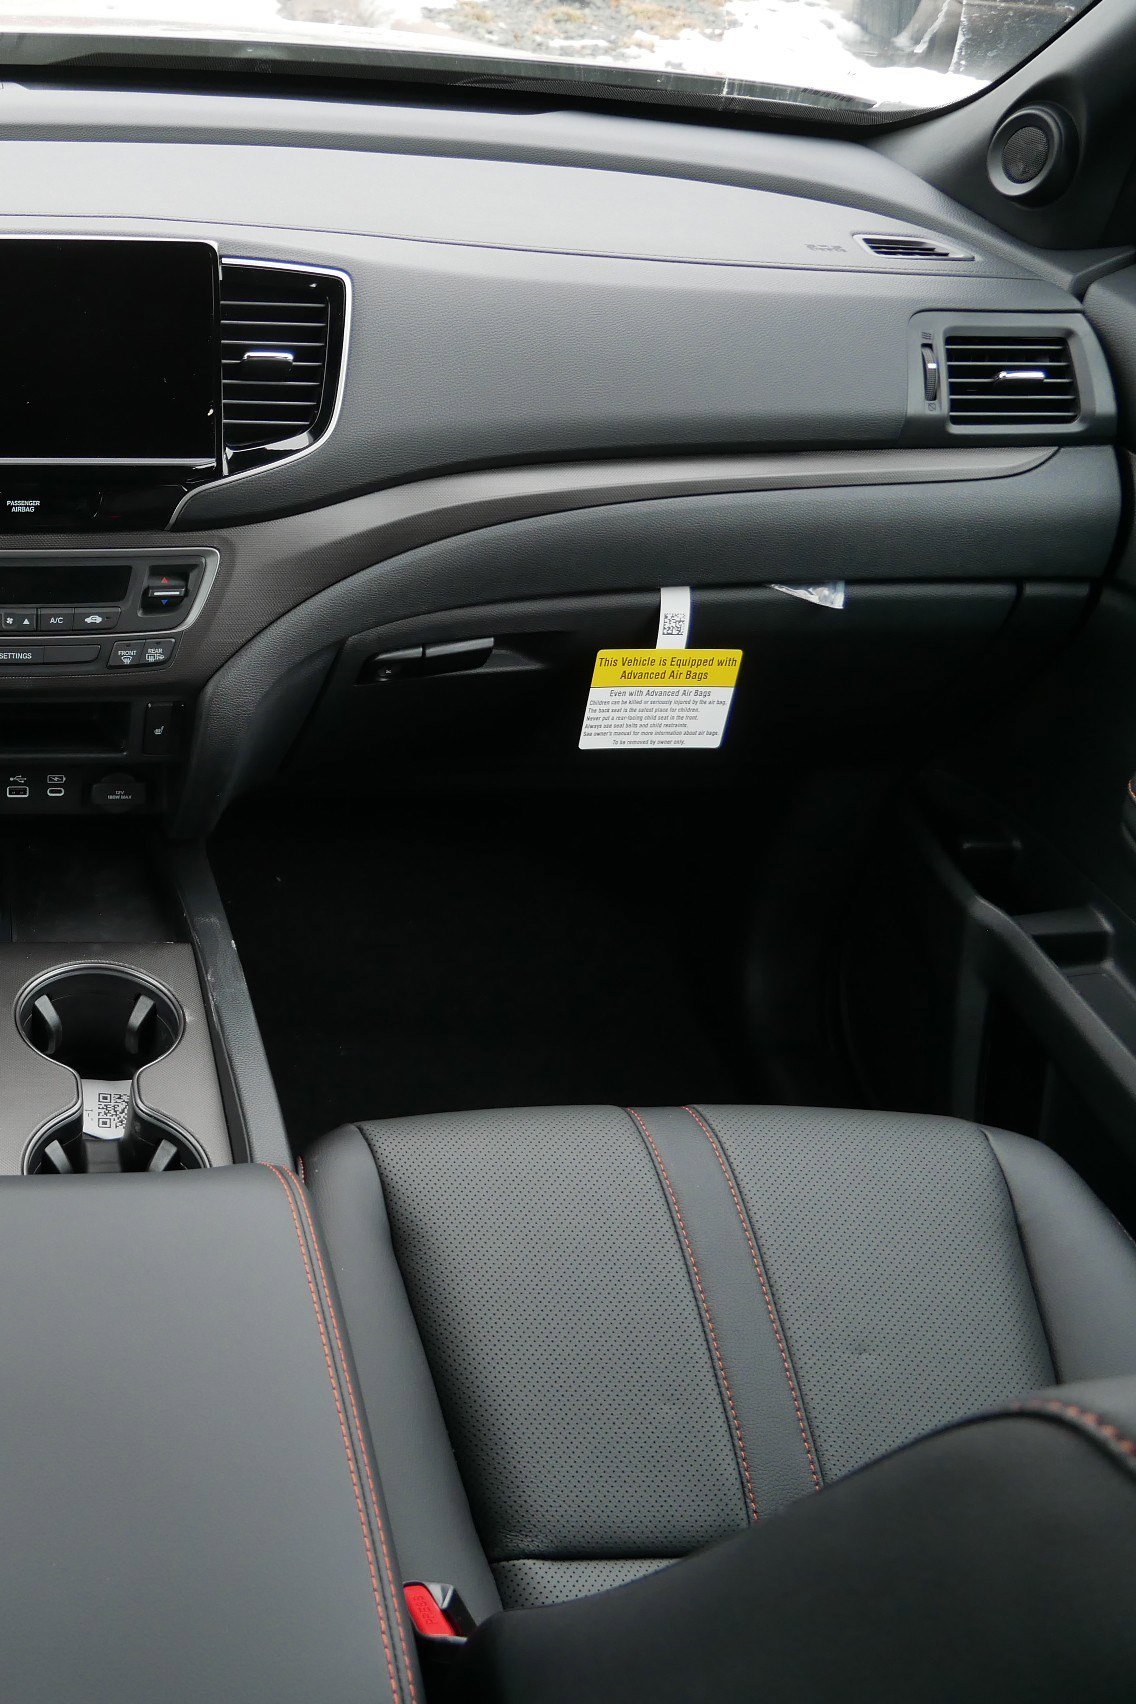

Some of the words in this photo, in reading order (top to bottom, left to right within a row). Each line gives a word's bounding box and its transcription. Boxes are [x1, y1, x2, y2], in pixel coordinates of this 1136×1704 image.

[599, 657, 618, 667] This
[621, 657, 656, 667] Vehicle
[659, 657, 667, 666] is
[670, 657, 714, 668] Equipped
[717, 657, 737, 667] with
[620, 670, 666, 680] Advanced
[668, 670, 683, 680] Air
[685, 670, 708, 681] Bags
[645, 689, 680, 697] Advanced
[682, 689, 692, 697] Air
[694, 690, 711, 698] Bags
